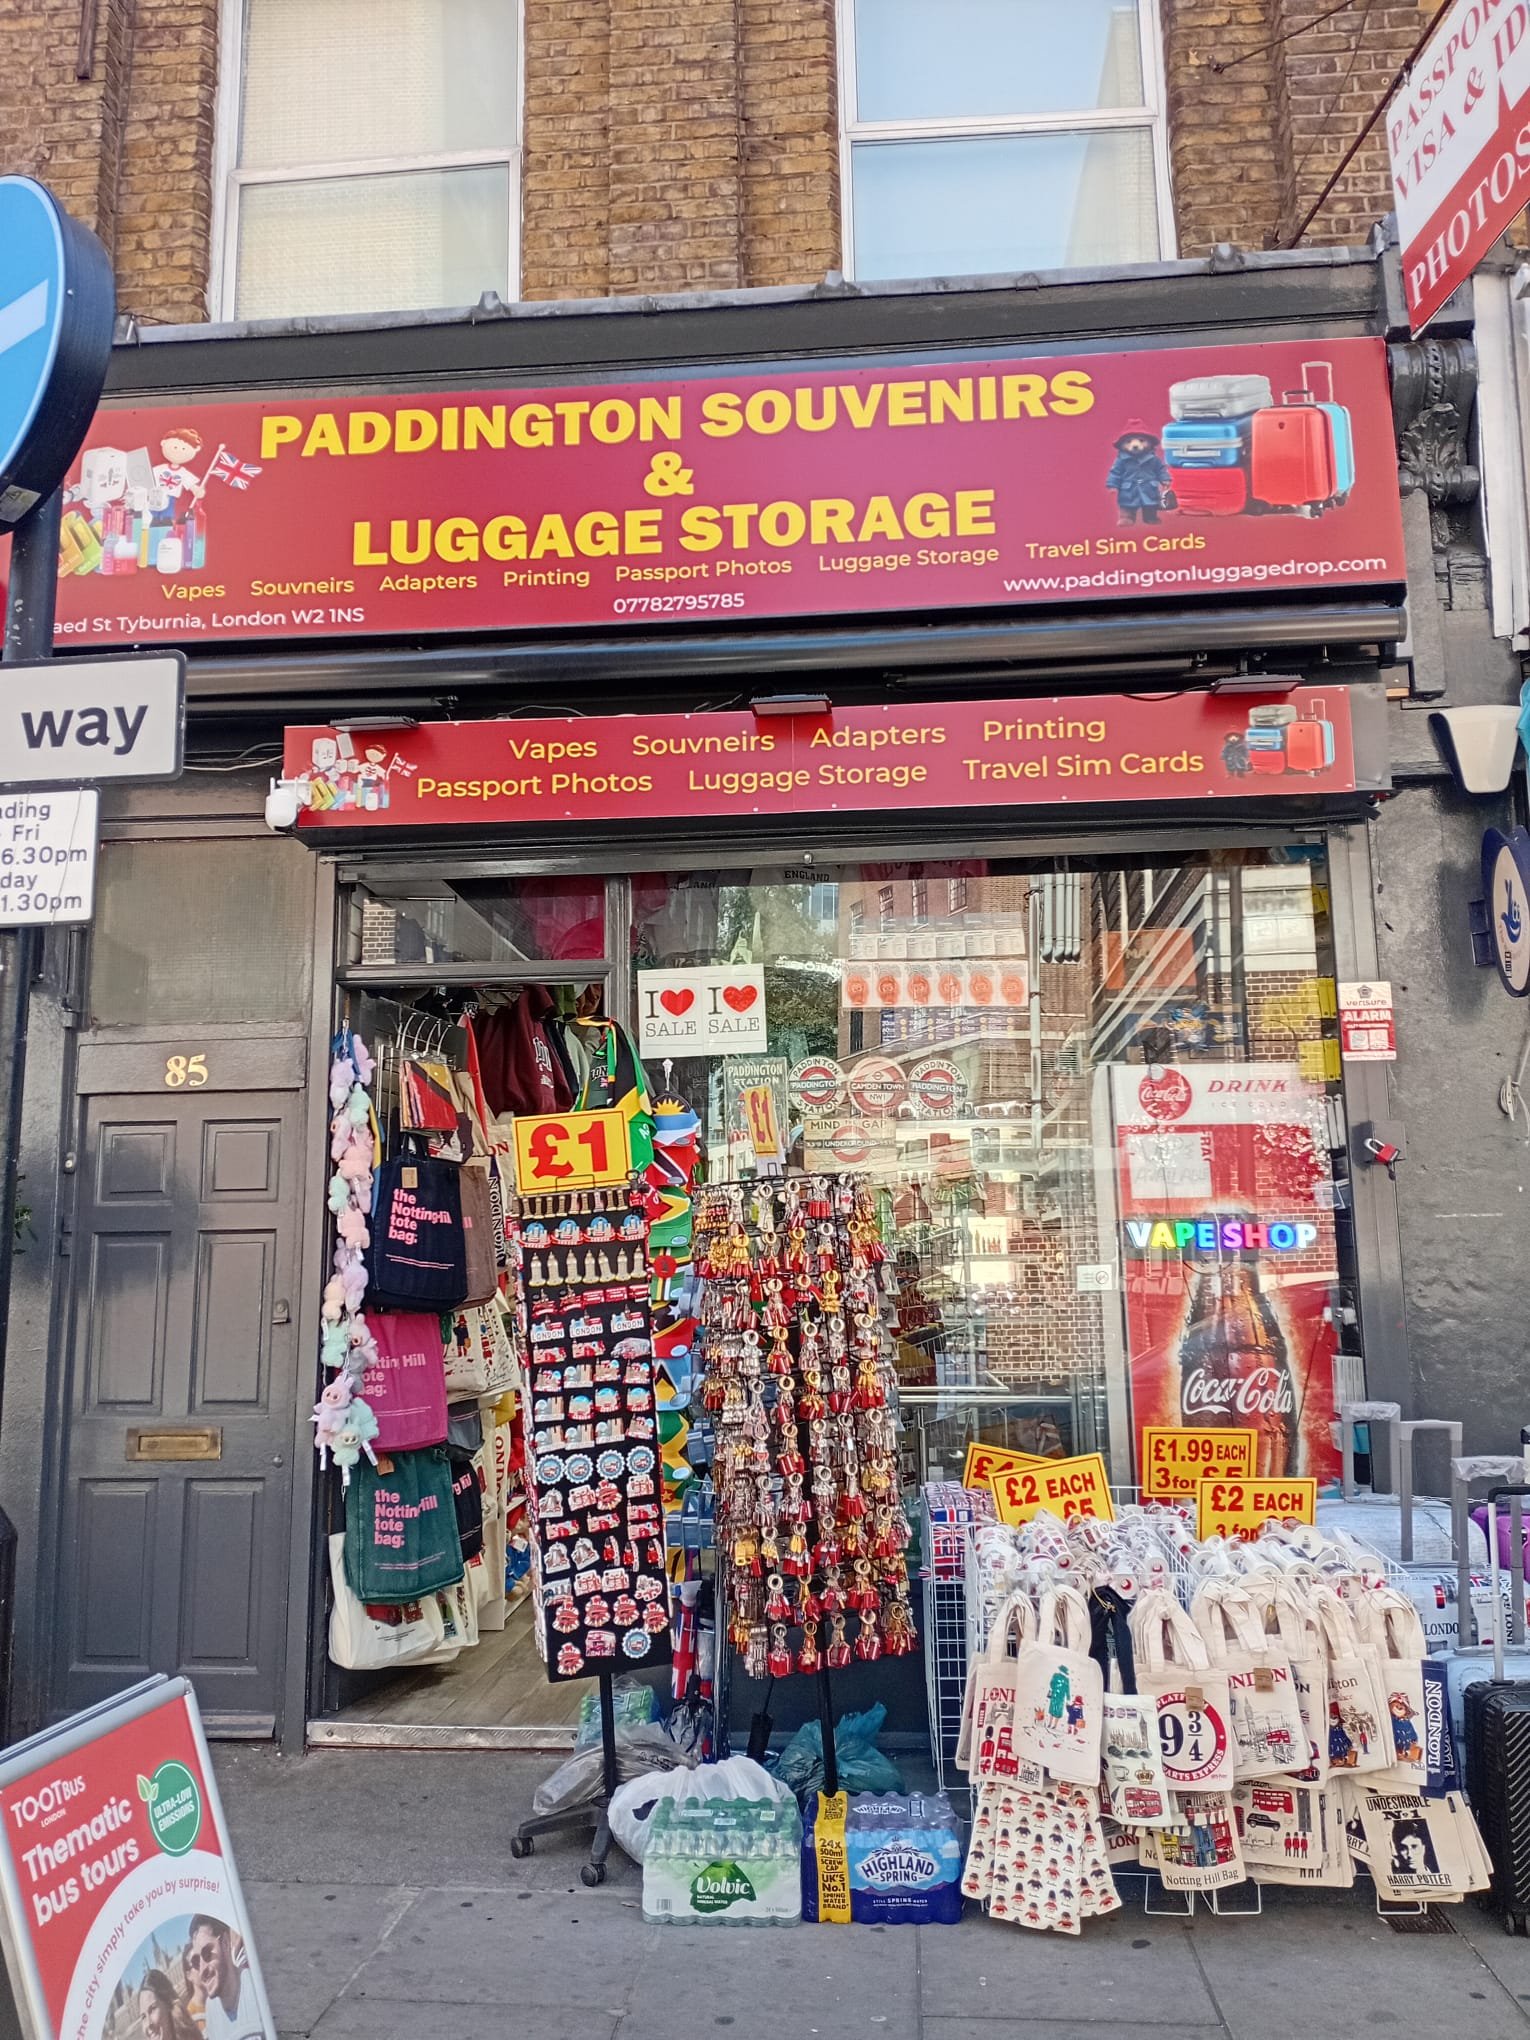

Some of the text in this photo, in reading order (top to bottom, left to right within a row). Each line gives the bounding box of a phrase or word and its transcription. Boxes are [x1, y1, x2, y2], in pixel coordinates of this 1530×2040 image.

[1391, 0, 1501, 158] PASSPOR
[1395, 2, 1528, 200] VISA & ID
[1409, 119, 1530, 311] PHOTOS
[259, 370, 1095, 460] PADDINGTON SOUVENIRS
[643, 451, 695, 497] &
[352, 489, 996, 567] LUGGAGE STORAGE
[162, 532, 1206, 602] Vapes Souvneirs Adapters Printing Passport Photos Luggage Storage Travel Sim Cards
[1003, 554, 1387, 592] www.paddingtonluggagedrop.com
[613, 592, 745, 614] 07782795785
[53, 606, 365, 635] aed St Tyburnia, London W2 1NS
[21, 704, 148, 756] way
[509, 716, 1106, 764] Vapes Souvneirs Adapters Printing
[417, 749, 1204, 801] Passport Photos Luggage Storage Travel Sim Cards
[0, 801, 51, 822] ding
[12, 824, 40, 842] Fri
[1, 868, 38, 892] day
[784, 870, 830, 882] ENGLAND
[646, 986, 722, 1019] I I
[644, 1016, 760, 1038] SALE SALE
[1342, 1009, 1392, 1022] ALARM
[164, 1054, 209, 1088] 85
[728, 1063, 783, 1077] PADDINGTON
[733, 1077, 780, 1087] STATION
[791, 1079, 841, 1090] PADDINGTON
[851, 1082, 905, 1091] CAMDEN TOWN
[911, 1080, 963, 1094] PADDINGTON
[1207, 1079, 1289, 1093] DRINK
[750, 1091, 774, 1144] £1
[810, 1119, 841, 1130] MIND
[528, 1120, 609, 1179] £1
[393, 1188, 416, 1204] the
[390, 1214, 417, 1230] tote
[1126, 1221, 1317, 1250] VAPE SHOP
[531, 1319, 643, 1342] LONDON LONDON LONDON
[403, 1354, 426, 1368] Hill
[362, 1370, 385, 1382] ote
[1183, 1367, 1294, 1416] Coca-Cola
[1153, 1438, 1246, 1462] £1.99 EACH
[1155, 1466, 1171, 1489] 3
[374, 1489, 400, 1503] the
[1006, 1472, 1096, 1507] £2 EACH
[1211, 1485, 1303, 1512] £2 EACH
[1064, 1498, 1096, 1520] £5
[374, 1518, 404, 1532] tote
[1424, 1622, 1459, 1636] LONDO
[1158, 1713, 1184, 1757] 9
[1425, 1680, 1442, 1767] LONDON
[1192, 1749, 1224, 1779] EXPRESS
[153, 1786, 192, 1819] ULTRA-LOW
[1366, 1796, 1431, 1811] UNDESIRABLE
[41, 1808, 66, 1828] LONDON
[158, 1800, 195, 1832] EMISSIONS
[22, 1796, 133, 1882] Thematic
[1109, 1834, 1140, 1850] LON
[821, 1858, 843, 1866] SCREW
[861, 1855, 935, 1878] HIGHLAND
[32, 1838, 140, 1927] bus tours
[696, 1877, 751, 1894] Volvic
[822, 1874, 845, 1882] UK'S
[822, 1882, 846, 1892] No.1
[880, 1871, 918, 1882] SPRING
[1166, 1870, 1239, 1887] Notting Hill Bag
[1387, 1873, 1451, 1885] HARRY POTTER
[77, 1876, 220, 2040] he city simply take you by surprise!
